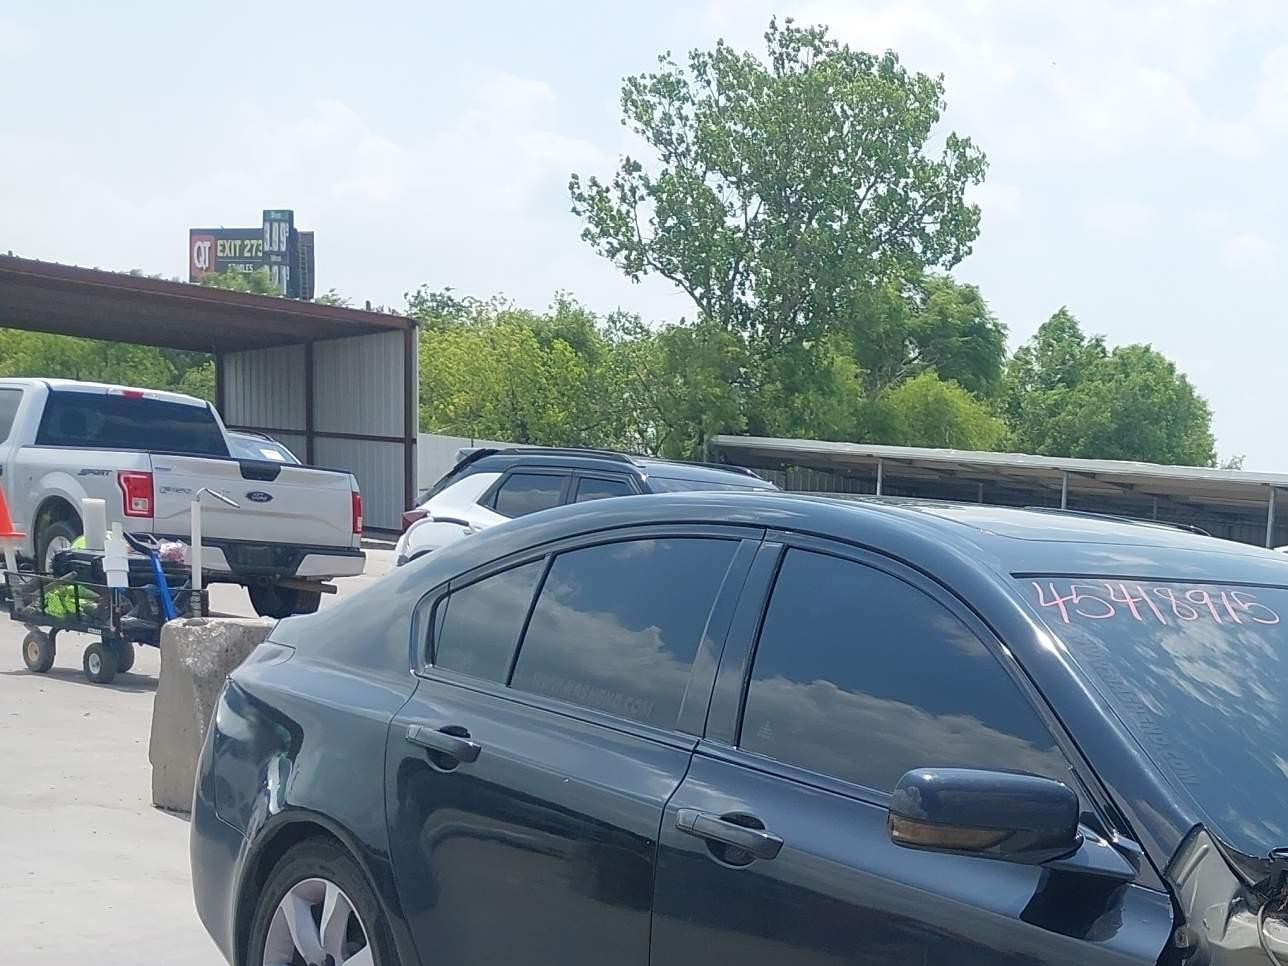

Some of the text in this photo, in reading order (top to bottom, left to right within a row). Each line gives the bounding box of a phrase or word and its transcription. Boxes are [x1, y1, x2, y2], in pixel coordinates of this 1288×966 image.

[194, 241, 211, 270] QT
[217, 239, 242, 257] EXIT
[78, 468, 112, 477] SPORT
[1031, 581, 1280, 625] 45418915
